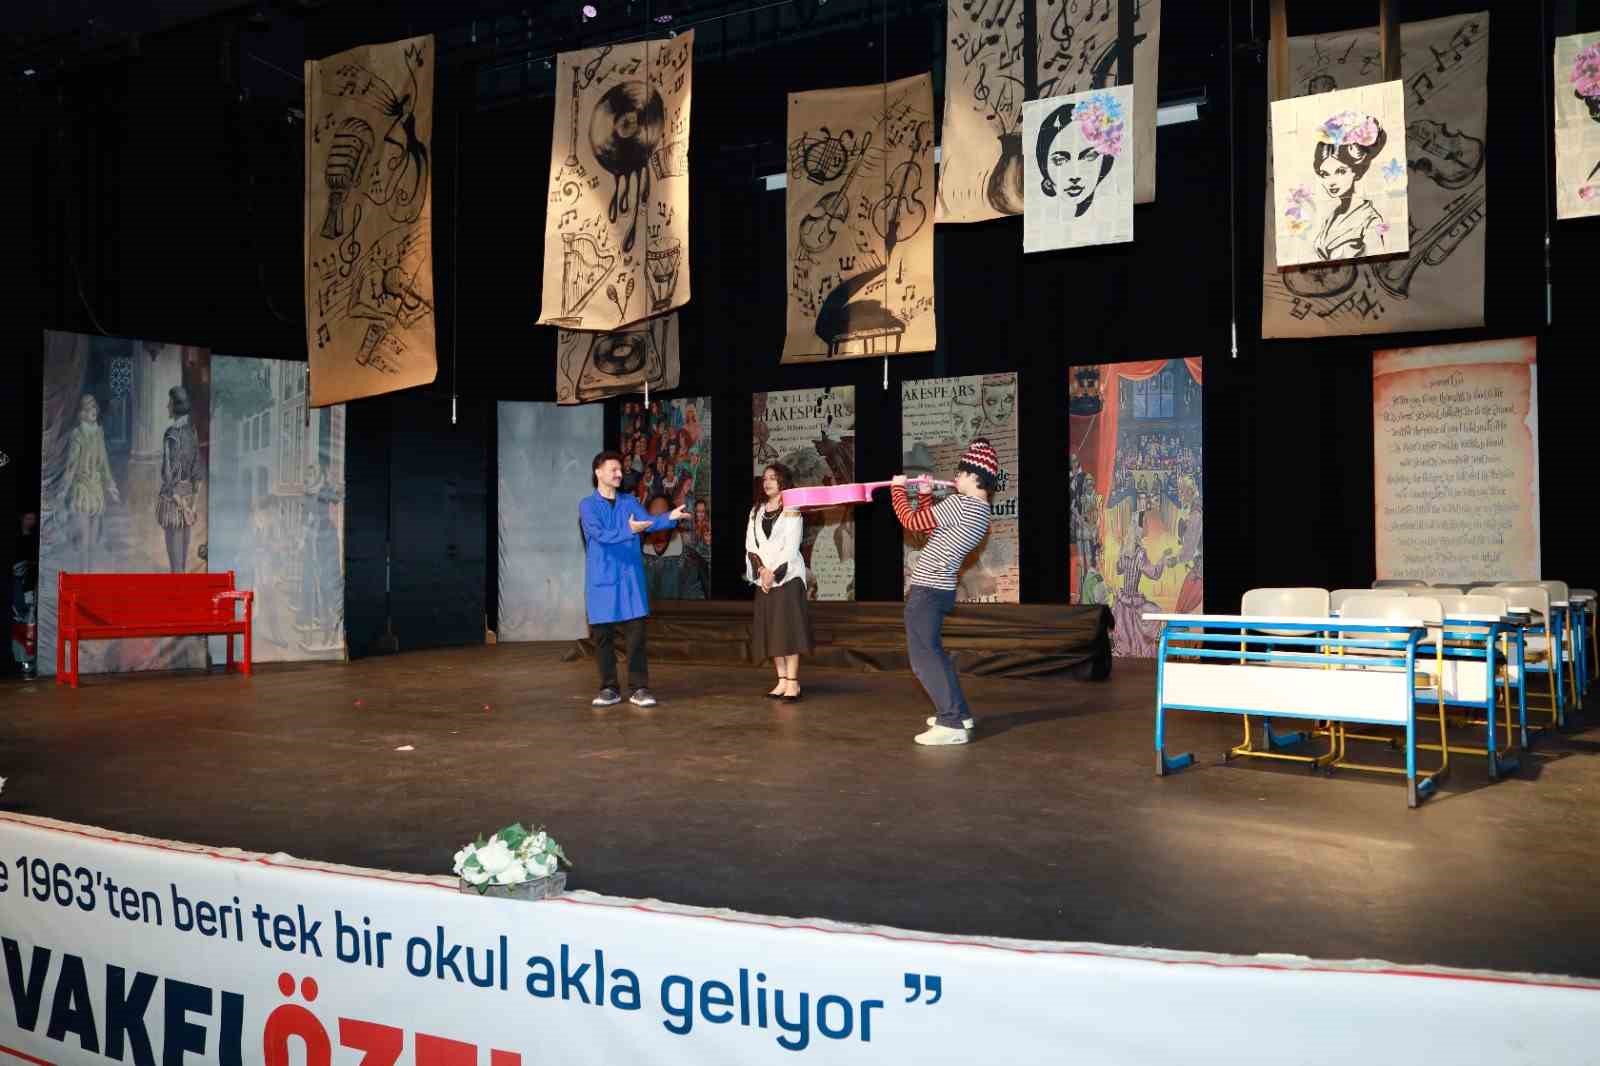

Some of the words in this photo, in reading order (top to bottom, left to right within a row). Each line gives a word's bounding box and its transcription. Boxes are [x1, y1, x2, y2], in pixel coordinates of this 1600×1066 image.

[16, 855, 163, 927] 1963'ten
[170, 883, 244, 943] beri
[252, 903, 323, 959] tek
[335, 909, 393, 969] bir
[407, 925, 508, 991] okul
[527, 943, 642, 1011] akla
[661, 967, 885, 1052] geliyor
